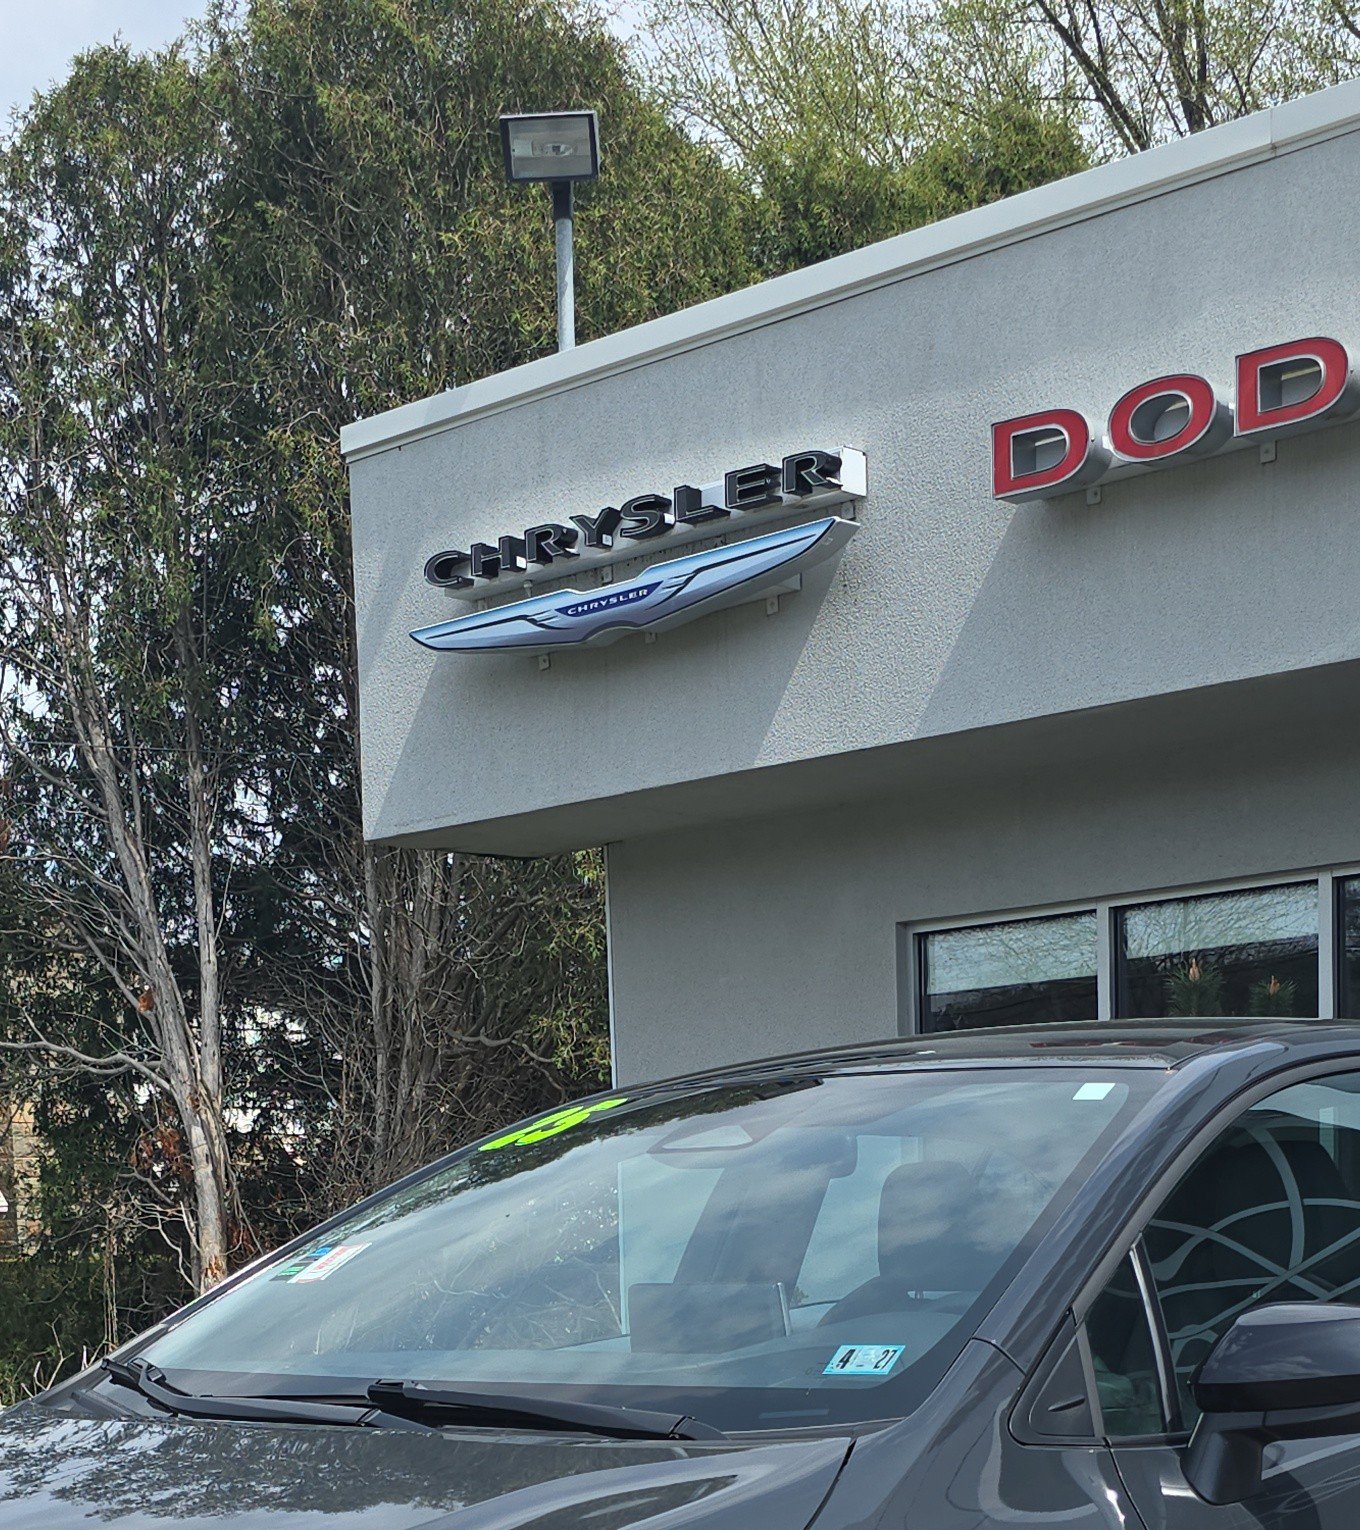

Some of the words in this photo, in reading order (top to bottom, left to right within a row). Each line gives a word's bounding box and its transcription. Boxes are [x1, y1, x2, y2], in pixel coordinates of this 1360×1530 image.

[423, 449, 843, 589] CHRYSLER
[567, 588, 648, 615] CHRYSLER
[835, 1348, 856, 1370] 4
[872, 1348, 899, 1370] 27
